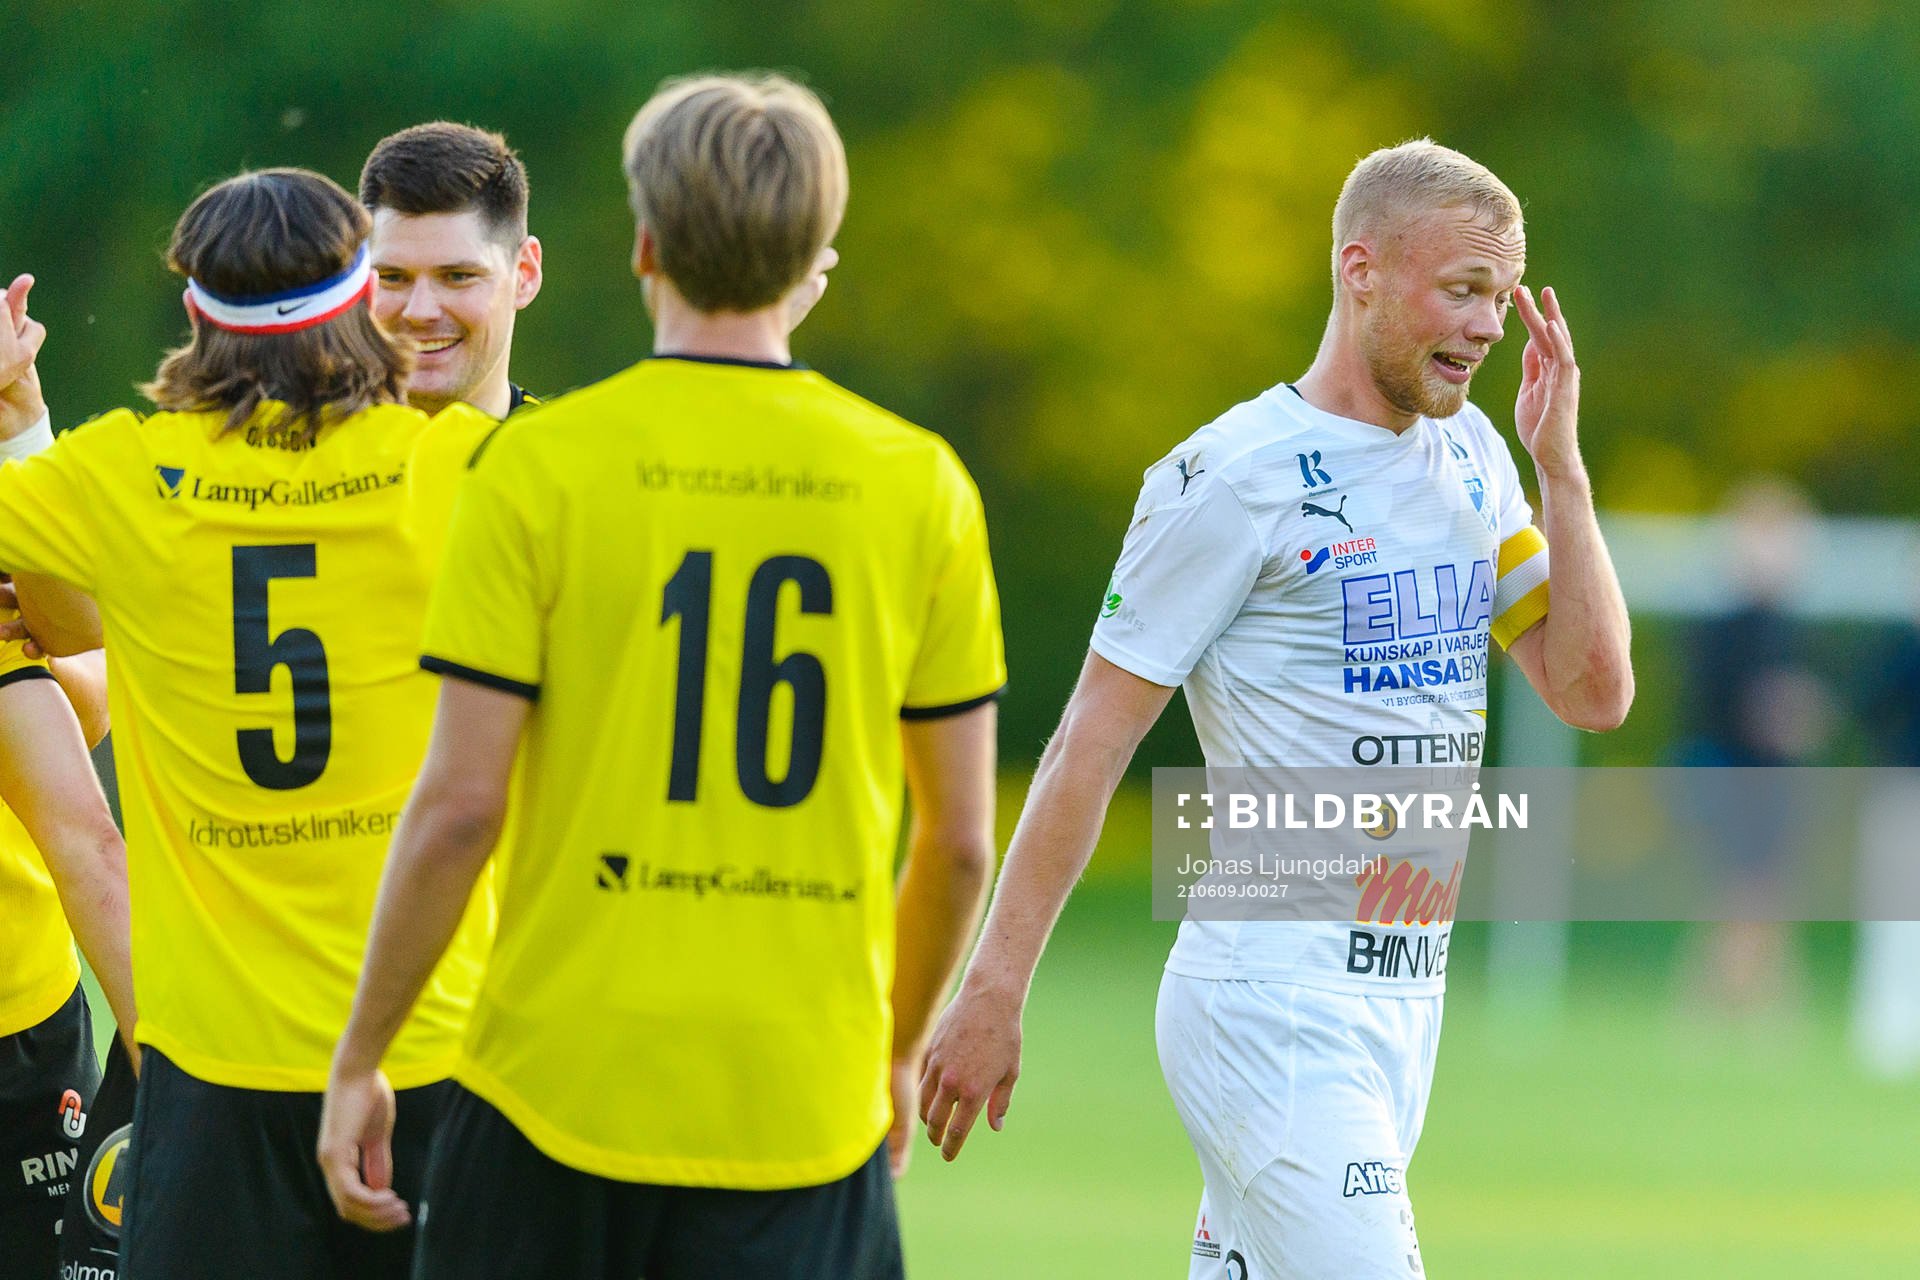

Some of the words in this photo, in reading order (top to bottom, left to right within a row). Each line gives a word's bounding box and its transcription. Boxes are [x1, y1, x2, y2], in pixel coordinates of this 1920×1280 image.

[1332, 537, 1376, 557] INTER
[1334, 551, 1378, 570] SPORT
[1344, 640, 1433, 663] KUNSKAP
[231, 543, 331, 791] 5
[659, 550, 834, 808] 16
[1396, 694, 1436, 707] BYGGER
